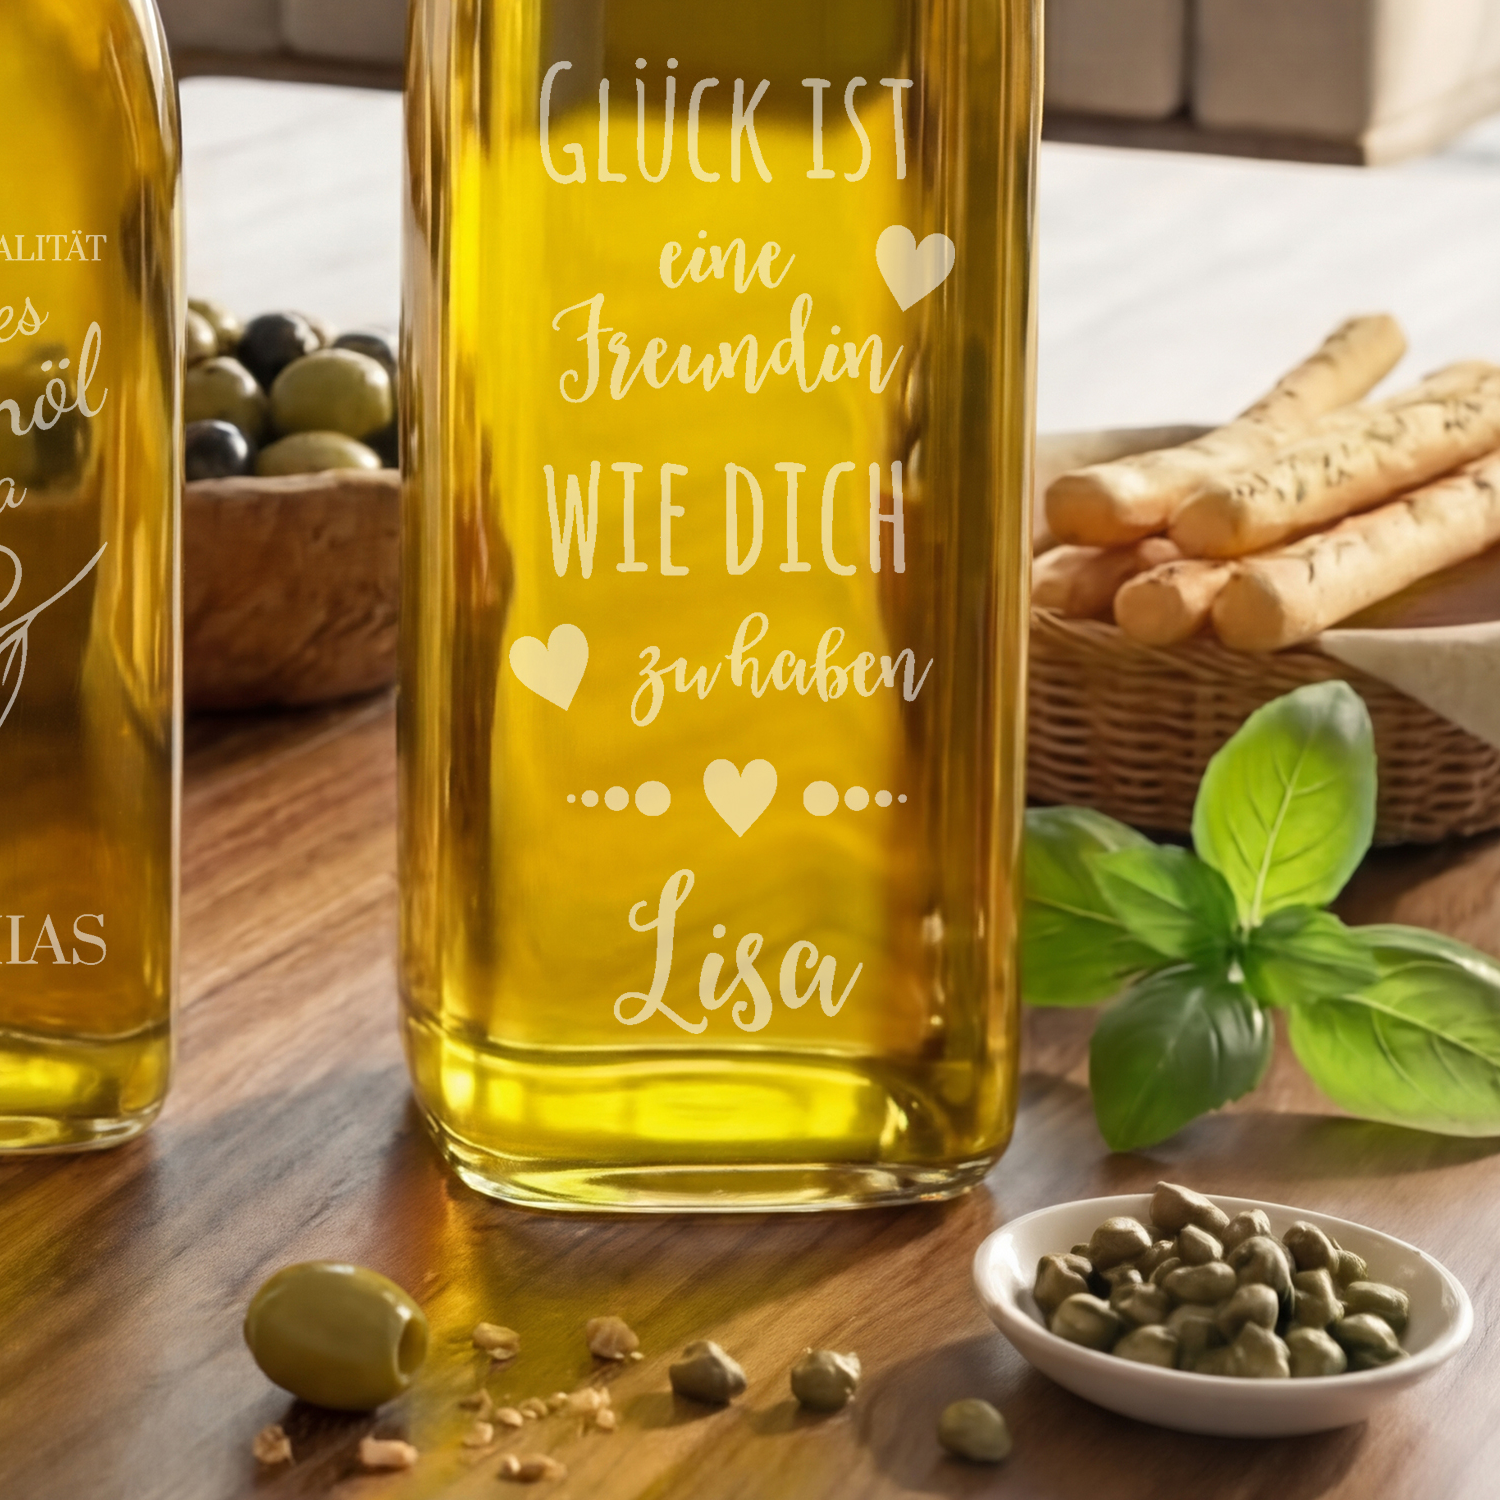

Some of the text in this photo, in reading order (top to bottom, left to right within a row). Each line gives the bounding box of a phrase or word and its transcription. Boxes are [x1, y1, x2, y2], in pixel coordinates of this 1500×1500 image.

[540, 57, 913, 184] GLÜCK IST
[658, 230, 795, 293] eine
[552, 293, 904, 403] Freundin
[543, 460, 906, 580] WIE DICH
[613, 868, 863, 1035] Lisa
